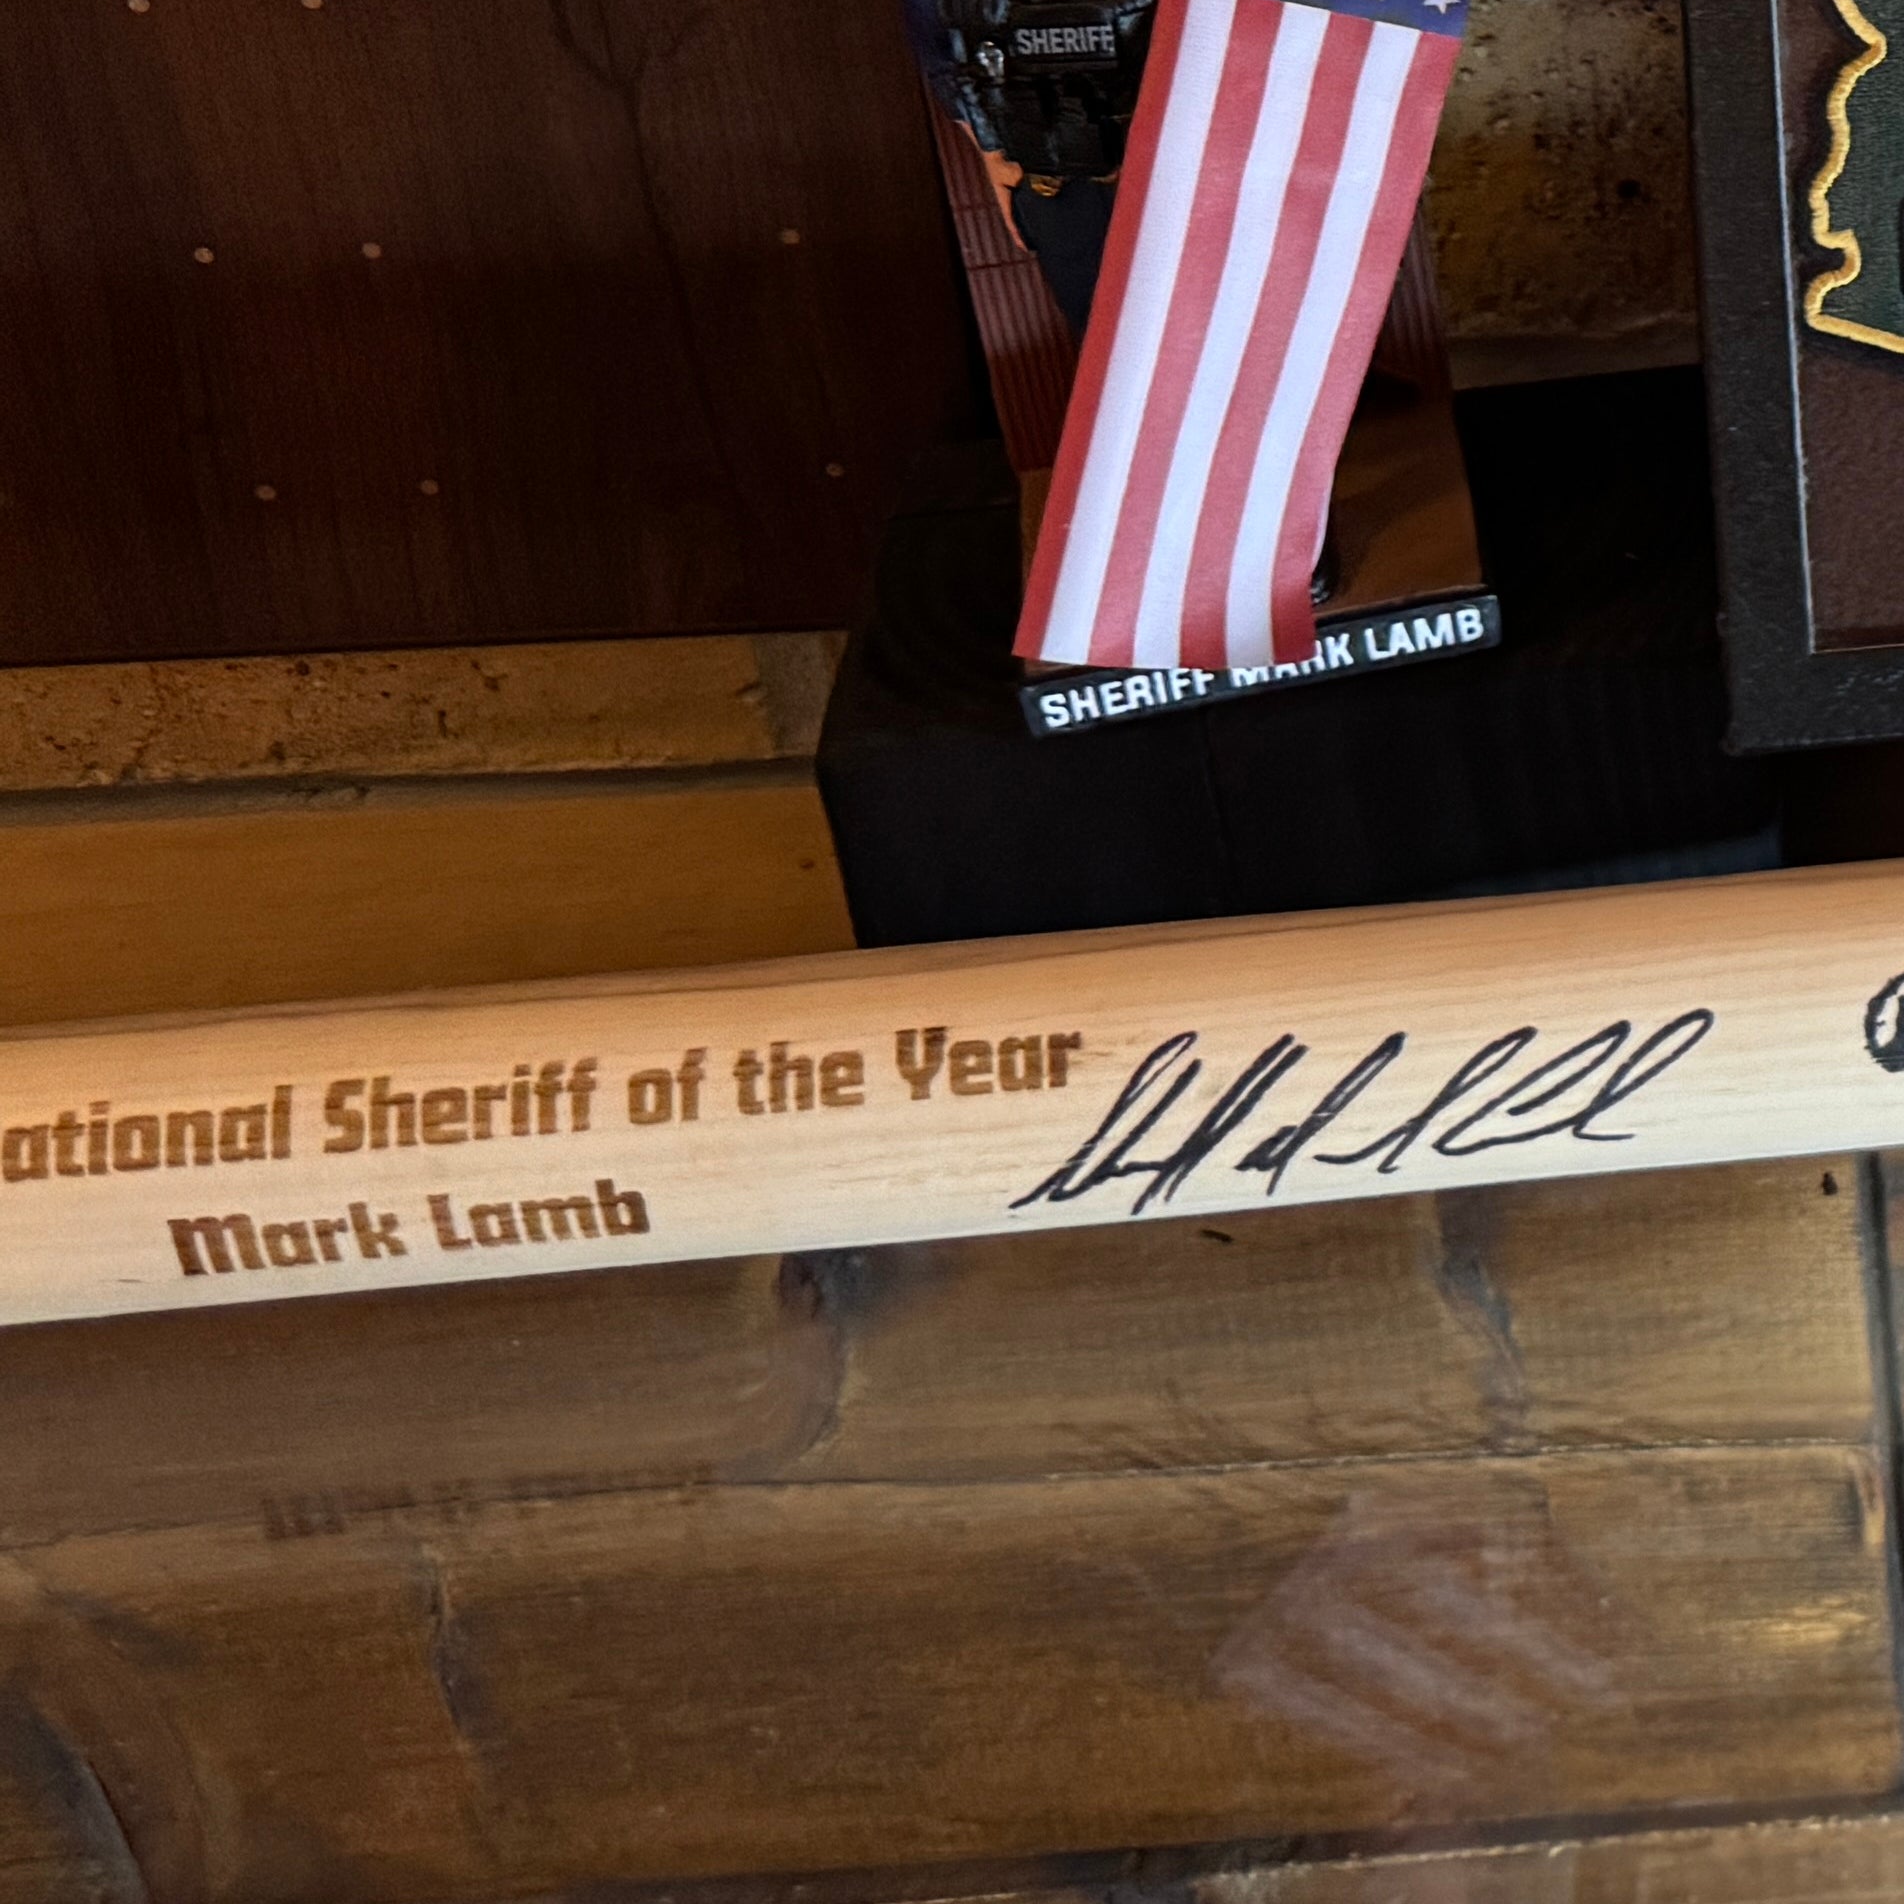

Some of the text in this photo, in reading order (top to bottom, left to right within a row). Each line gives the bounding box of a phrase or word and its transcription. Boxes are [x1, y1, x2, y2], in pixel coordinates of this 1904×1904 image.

[1016, 24, 1114, 55] SHERIFF
[1039, 668, 1214, 728] SHERIFF
[1364, 608, 1484, 661] LAMB
[2, 1027, 1082, 1184] ational Sheriff of the Year
[167, 1179, 650, 1279] Mark Lamb
